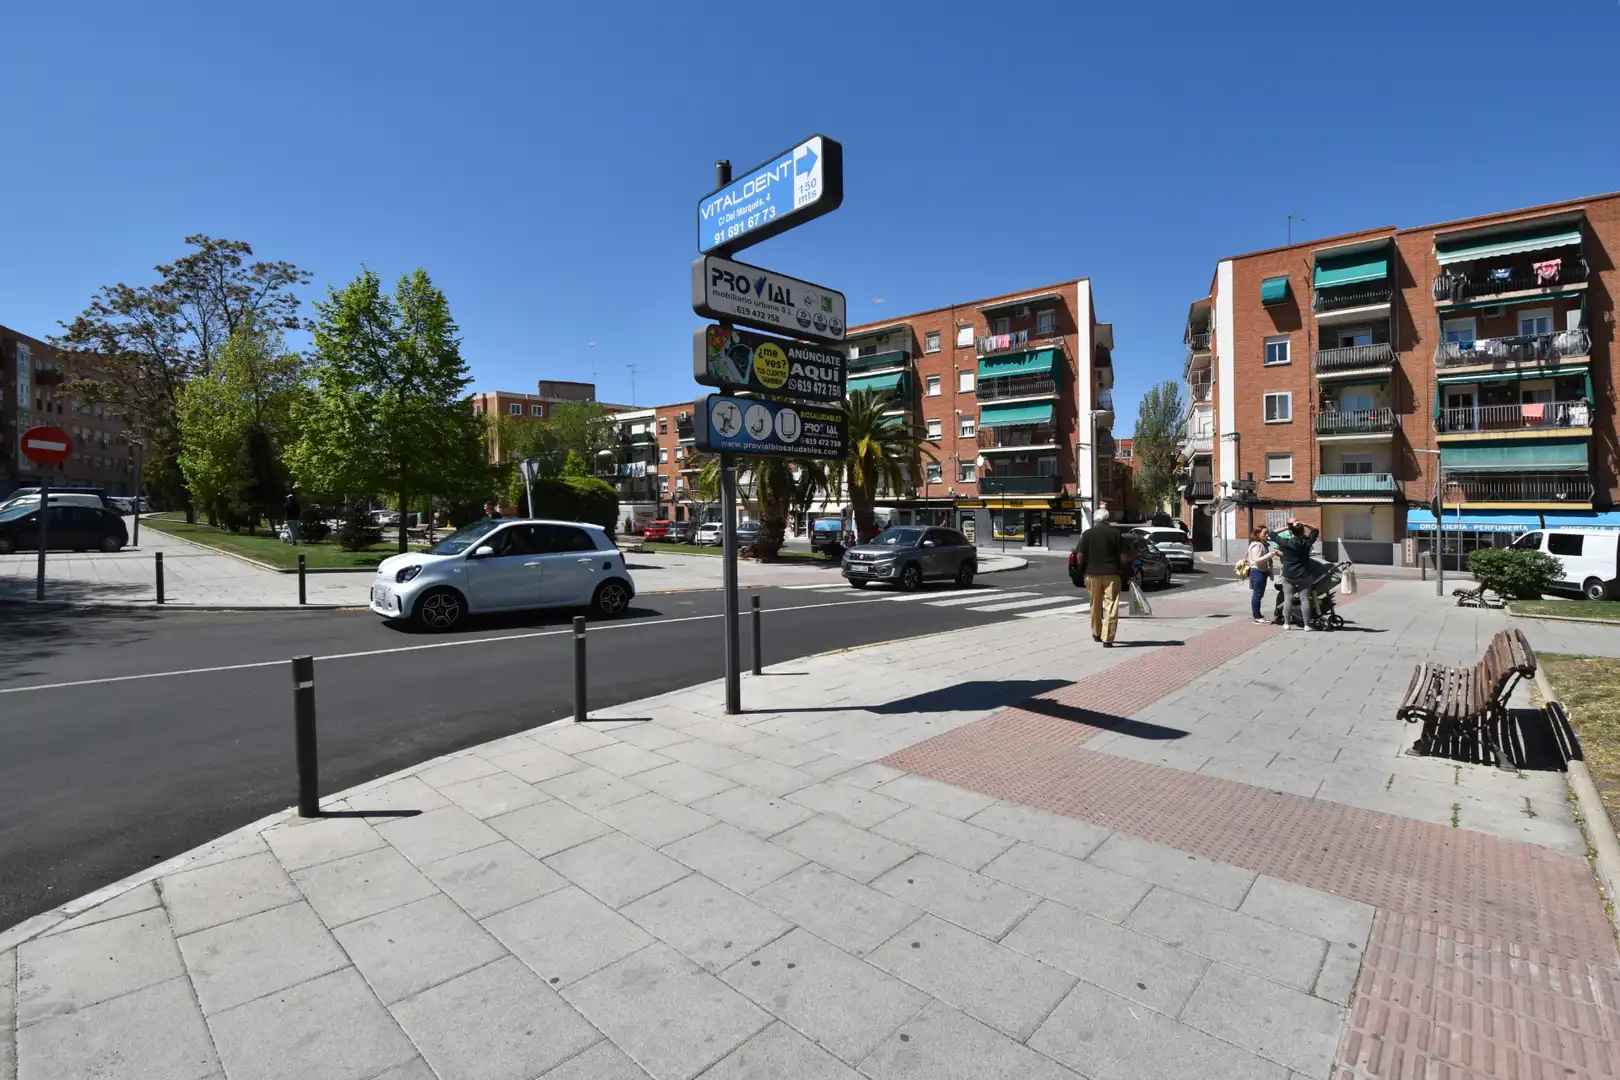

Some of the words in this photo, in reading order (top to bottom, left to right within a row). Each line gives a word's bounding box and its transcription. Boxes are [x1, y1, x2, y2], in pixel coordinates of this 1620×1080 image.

[701, 160, 792, 220] VITALDENT
[799, 178, 817, 192] 150
[798, 191, 817, 205] mts
[725, 212, 736, 223] Del
[766, 193, 771, 202] 4
[714, 230, 725, 244] 91
[727, 220, 744, 238] 691
[747, 212, 759, 228] 67
[762, 206, 776, 221] 73
[712, 289, 752, 305] mobiliario
[753, 297, 780, 313] urbano
[736, 306, 751, 316] 619
[752, 309, 765, 319] 472
[767, 313, 780, 323] 758
[758, 347, 778, 359] ¿me
[788, 347, 841, 366] ANÚNCIATE
[765, 359, 787, 369] ves?
[790, 362, 840, 382] AQUÍ
[797, 380, 812, 393] 619
[813, 382, 827, 396] 472
[828, 384, 842, 397] 758
[800, 410, 842, 423] BIOSALUDABLES
[720, 440, 838, 456] www.provialbiosaludables.com
[805, 437, 817, 445] 619
[818, 439, 829, 447] 472
[830, 440, 842, 448] 758
[1420, 523, 1467, 531] DROUERÍA
[1473, 524, 1528, 532] PERFUMERÍA
